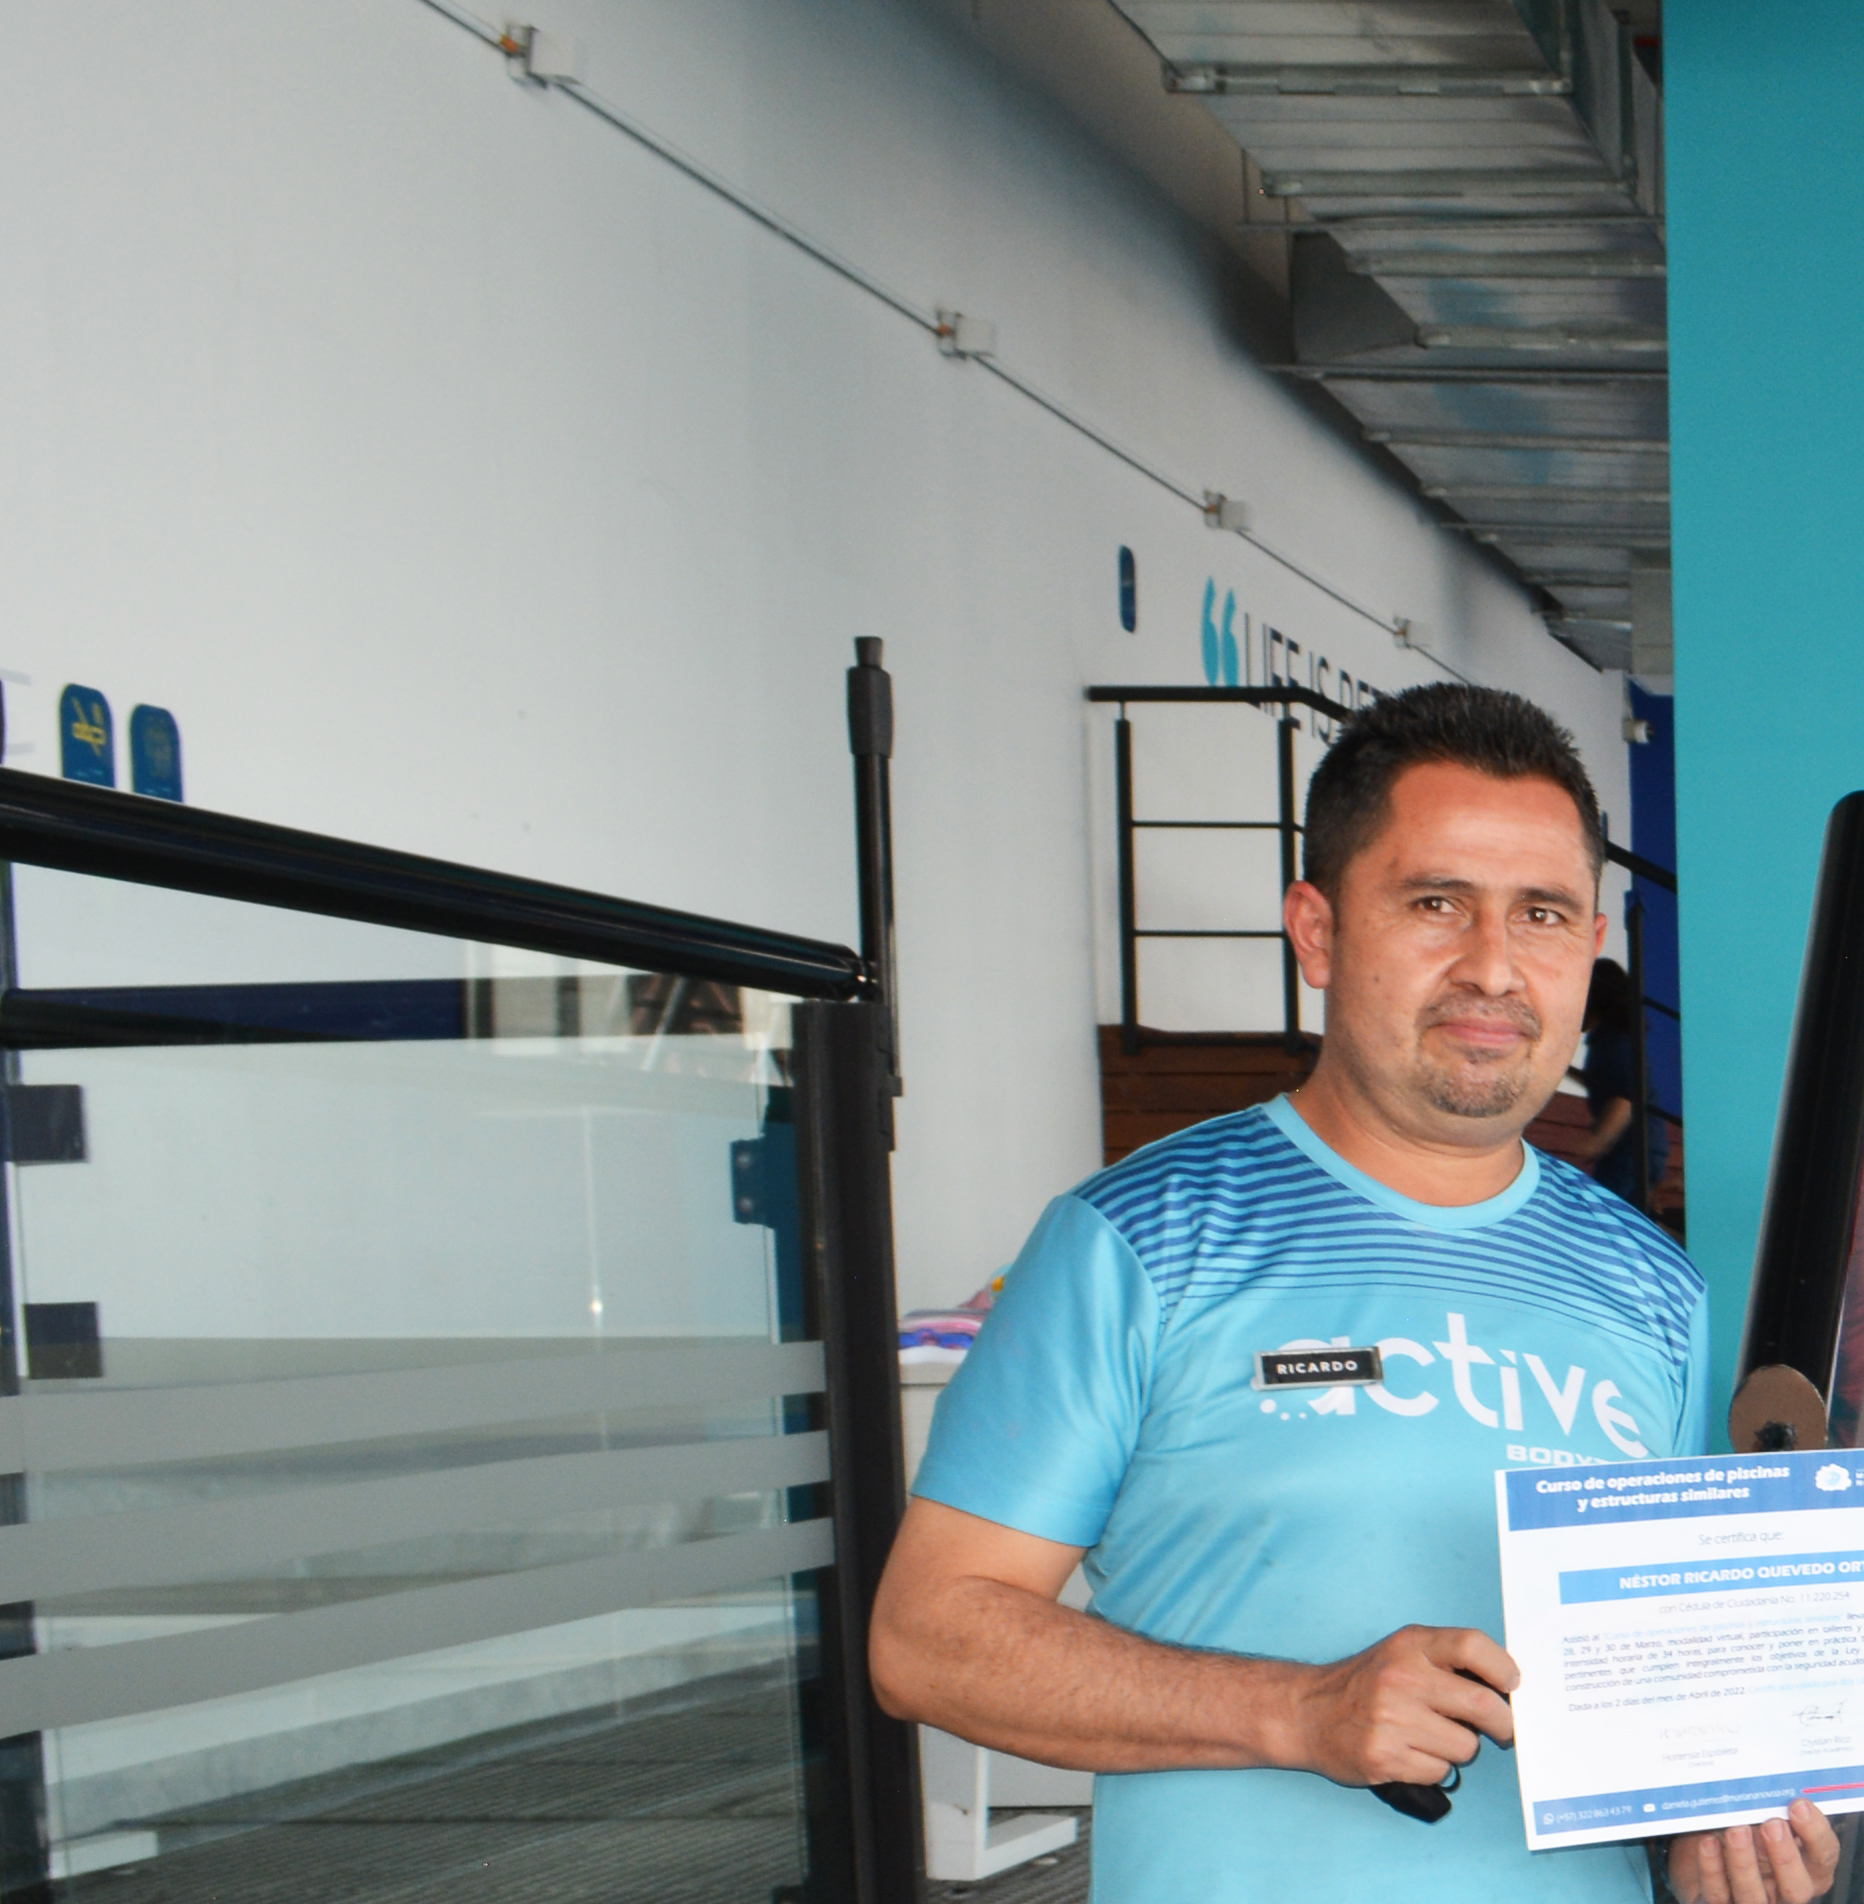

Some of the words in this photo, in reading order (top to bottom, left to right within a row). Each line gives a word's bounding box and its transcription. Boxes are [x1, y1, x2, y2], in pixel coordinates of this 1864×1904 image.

[1275, 1358, 1359, 1377] RICARDO
[1536, 1478, 1581, 1493] Curso
[1584, 1476, 1604, 1490] de
[1607, 1469, 1701, 1491] operaciones
[1704, 1468, 1724, 1482] de
[1727, 1464, 1788, 1484] piscinas
[1577, 1498, 1587, 1512] y
[1590, 1491, 1677, 1508] estructuras
[1681, 1485, 1748, 1501] similares
[1684, 1567, 1753, 1583] RICARDO
[1757, 1561, 1834, 1578] QUEVEDO
